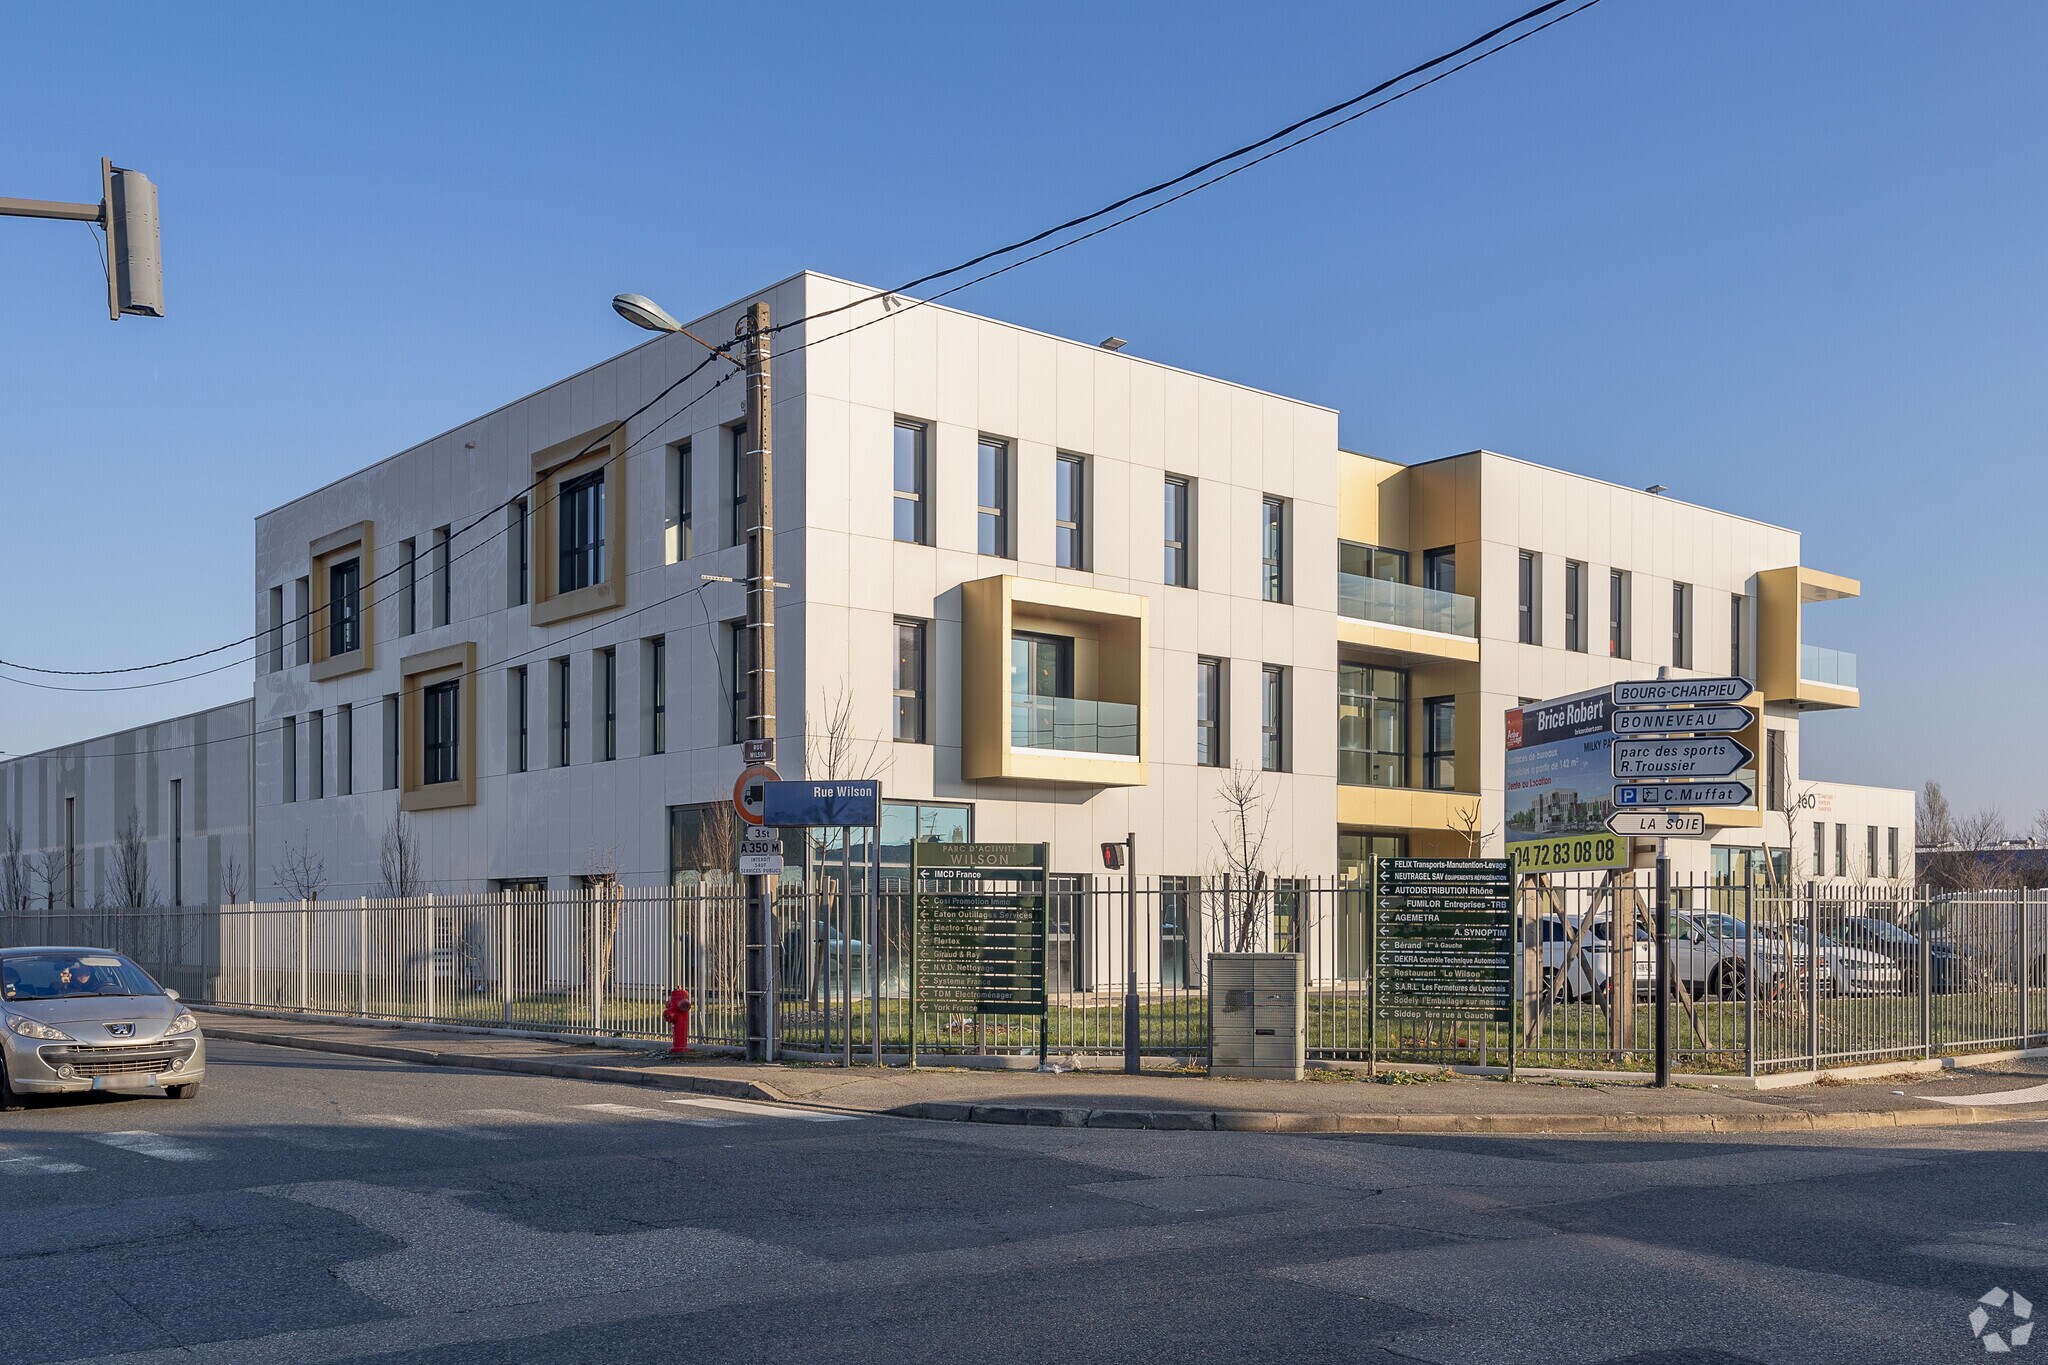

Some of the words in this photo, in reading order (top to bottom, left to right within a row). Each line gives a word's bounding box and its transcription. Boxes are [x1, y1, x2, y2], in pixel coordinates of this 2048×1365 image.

[1621, 684, 1736, 699] BOURG-CHARPIEU
[1537, 707, 1565, 731] Brice
[1566, 699, 1604, 725] Robert
[1621, 714, 1717, 728] BONNEVEAU
[1584, 740, 1601, 752] MILKY
[1620, 749, 1650, 760] parc
[1655, 746, 1678, 756] des
[1683, 745, 1726, 758] sports
[1560, 759, 1570, 768] 142
[1621, 760, 1696, 772] R.Troussier
[814, 787, 834, 797] Rue
[837, 786, 872, 797] Wilson
[1623, 790, 1634, 802] P
[1640, 818, 1656, 830] LA
[1665, 818, 1699, 830] SOIE
[741, 843, 748, 853] A
[749, 843, 769, 853] 350
[771, 843, 779, 852] M
[969, 844, 1017, 853] D'ACTIVITÉ
[1515, 846, 1530, 867] 04
[1533, 844, 1550, 866] 72
[1553, 842, 1570, 864] 83
[1574, 840, 1592, 863] 08
[1595, 839, 1615, 862] 08
[951, 854, 1009, 865] WILSON
[1394, 860, 1413, 868] FELIX
[934, 870, 954, 878] IMCD
[956, 871, 981, 879] France
[1394, 872, 1431, 880] NEUTRAGEL
[1394, 886, 1468, 894] AUTODISTRIBUTION
[1469, 887, 1494, 895] Rhône
[952, 897, 989, 905] Promotion
[1406, 900, 1441, 908] FUMILOR
[1444, 900, 1486, 909] Entreprises
[1491, 901, 1507, 909] TRB
[958, 911, 997, 920] Outillages
[999, 911, 1033, 919] Services
[1394, 914, 1440, 922] AGEMETRA
[965, 924, 985, 932] Team
[1394, 955, 1419, 963] DEKRA
[1444, 957, 1473, 965] Technique
[957, 964, 995, 972] Nettoyage
[1394, 969, 1436, 977] Restaurant
[966, 977, 992, 985] France
[1421, 983, 1433, 991] Les
[1469, 984, 1477, 992] du
[1478, 985, 1506, 993] Lyonnais
[933, 990, 951, 998] TDM
[955, 991, 1013, 1000] Electroménager
[1394, 996, 1419, 1005] Sodely
[1422, 997, 1464, 1006] l'Emballage
[1394, 1010, 1421, 1018] Siddep
[1425, 1010, 1440, 1018] 1ère
[1464, 1011, 1494, 1019] Gauche
